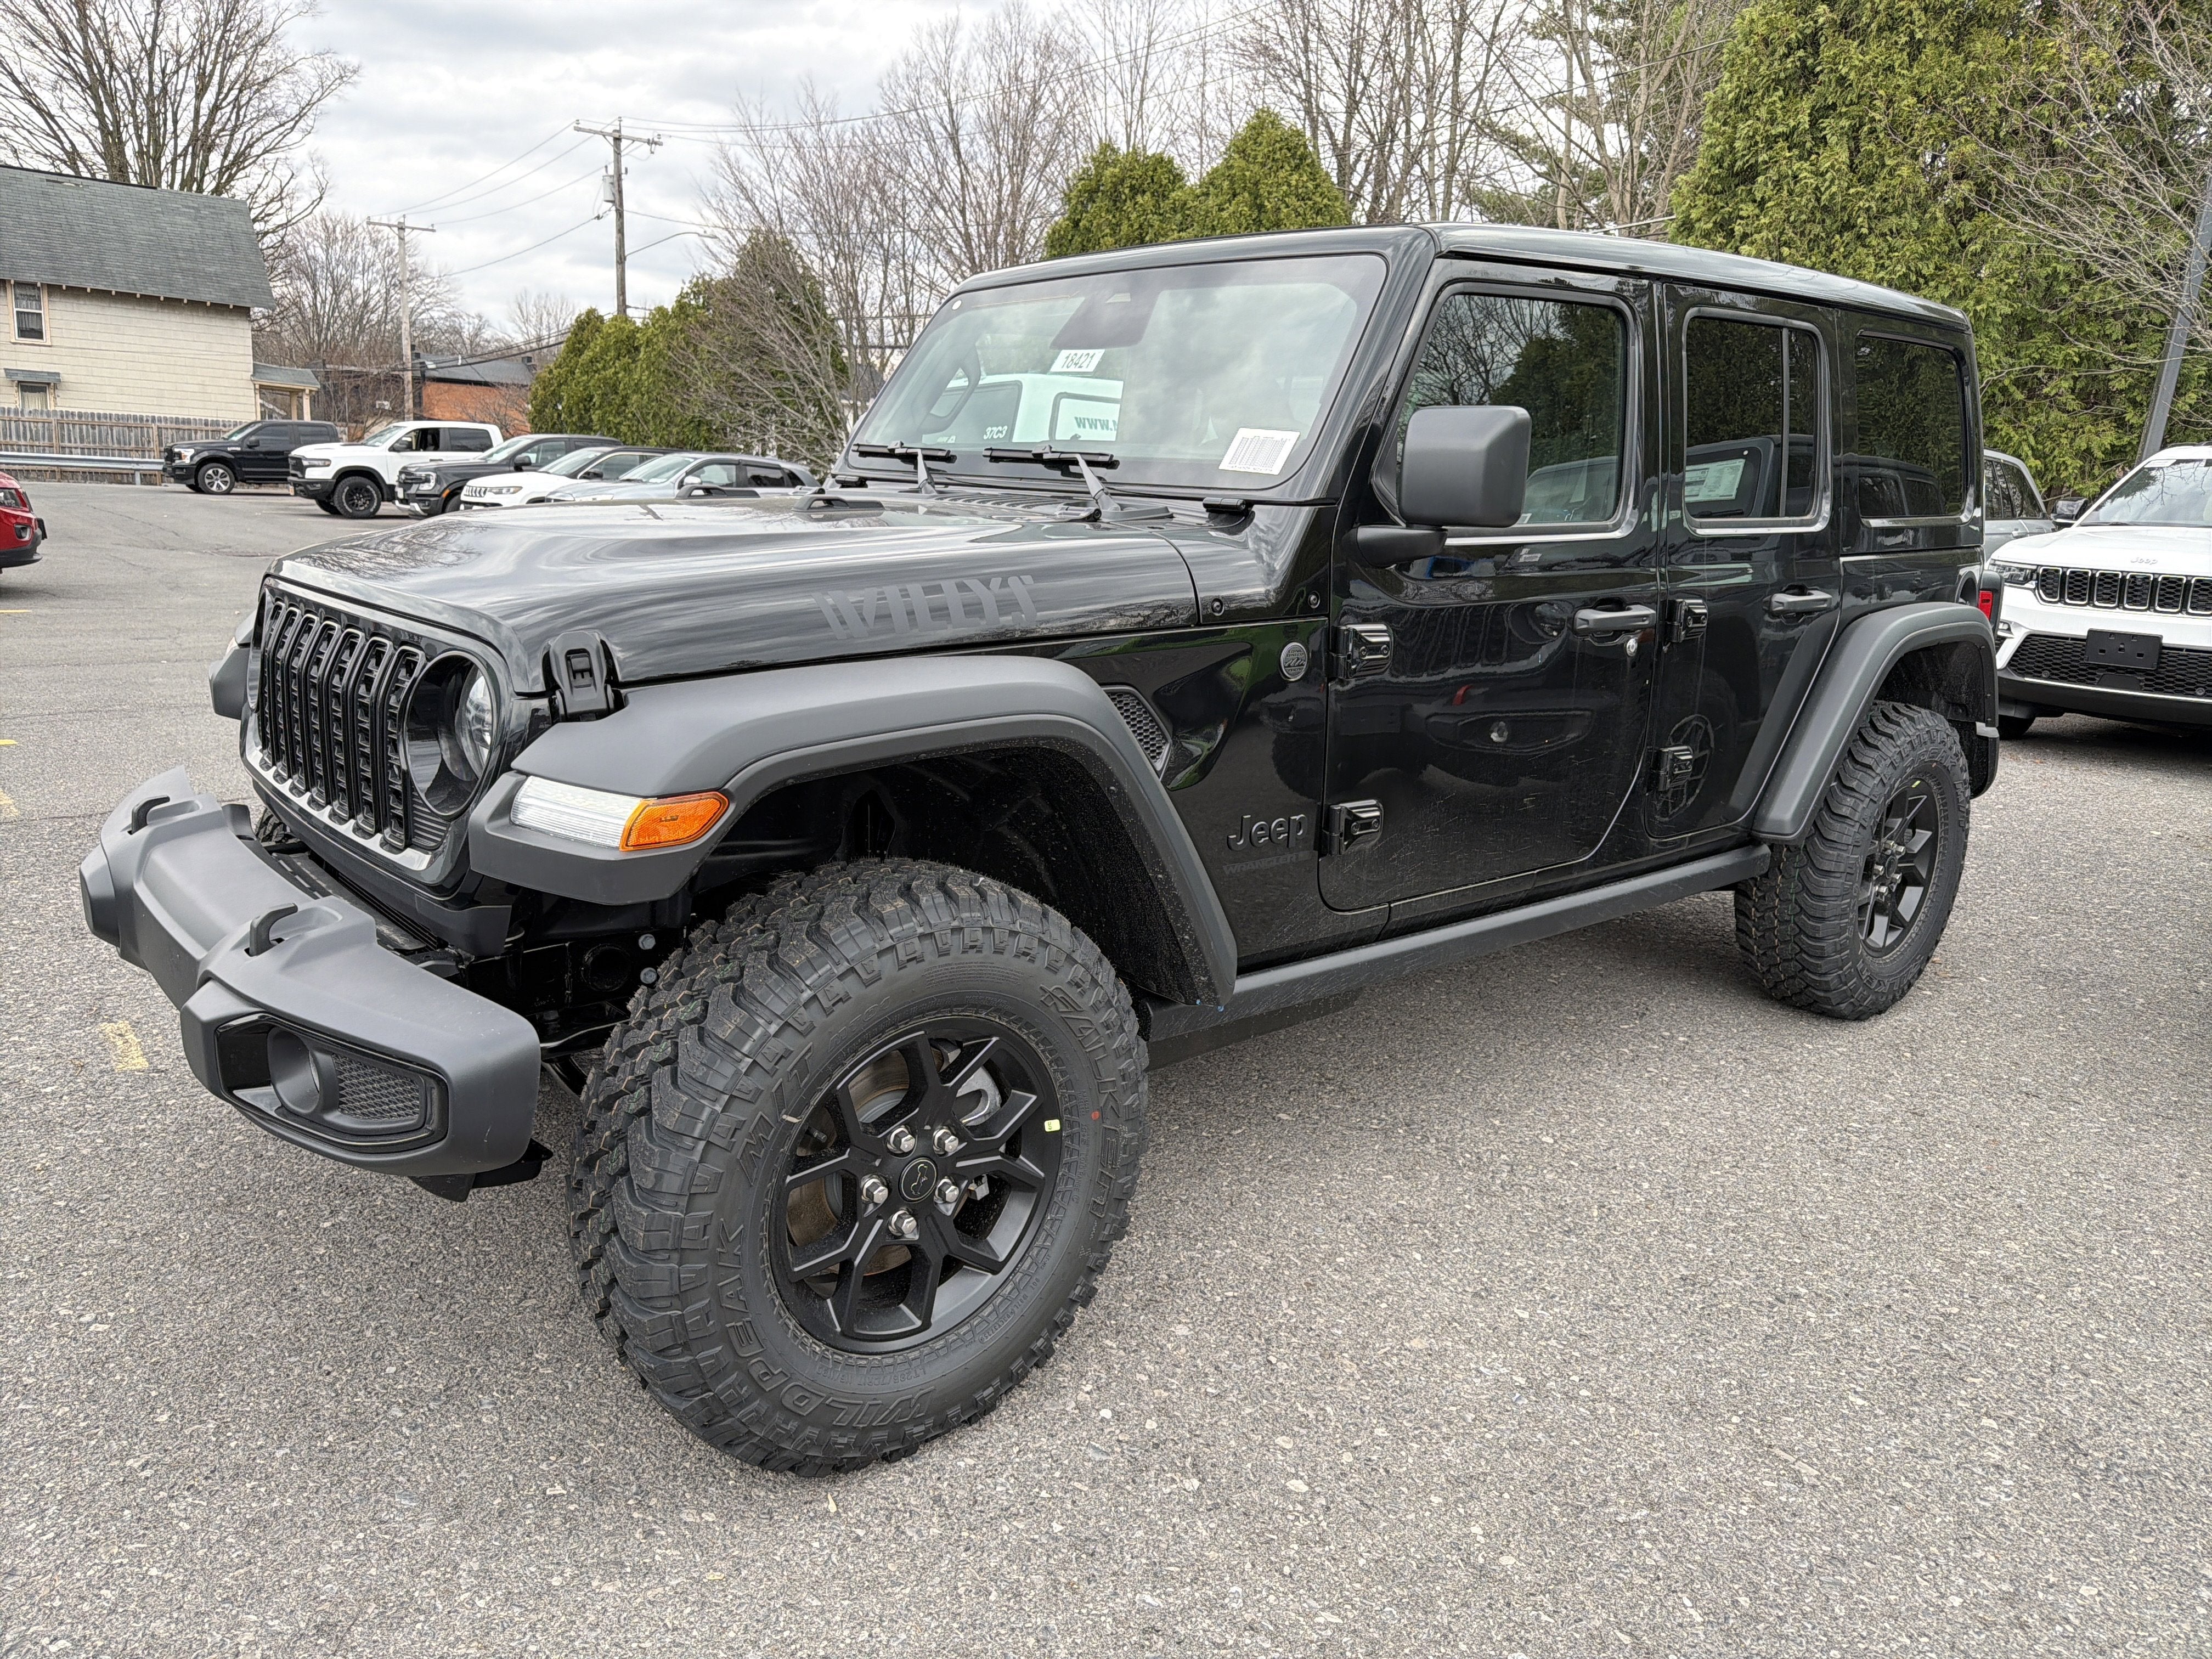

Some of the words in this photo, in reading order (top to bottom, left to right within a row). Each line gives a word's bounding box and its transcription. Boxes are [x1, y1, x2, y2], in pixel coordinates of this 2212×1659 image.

[1062, 353, 1096, 369] 18421
[984, 426, 1008, 440] 37C3
[811, 575, 1037, 640] WILLYS
[1227, 814, 1308, 851] Jeep
[1223, 853, 1297, 875] WRANGLER
[738, 1042, 814, 1187] M/T
[716, 1218, 935, 1426] WILDPEAK
